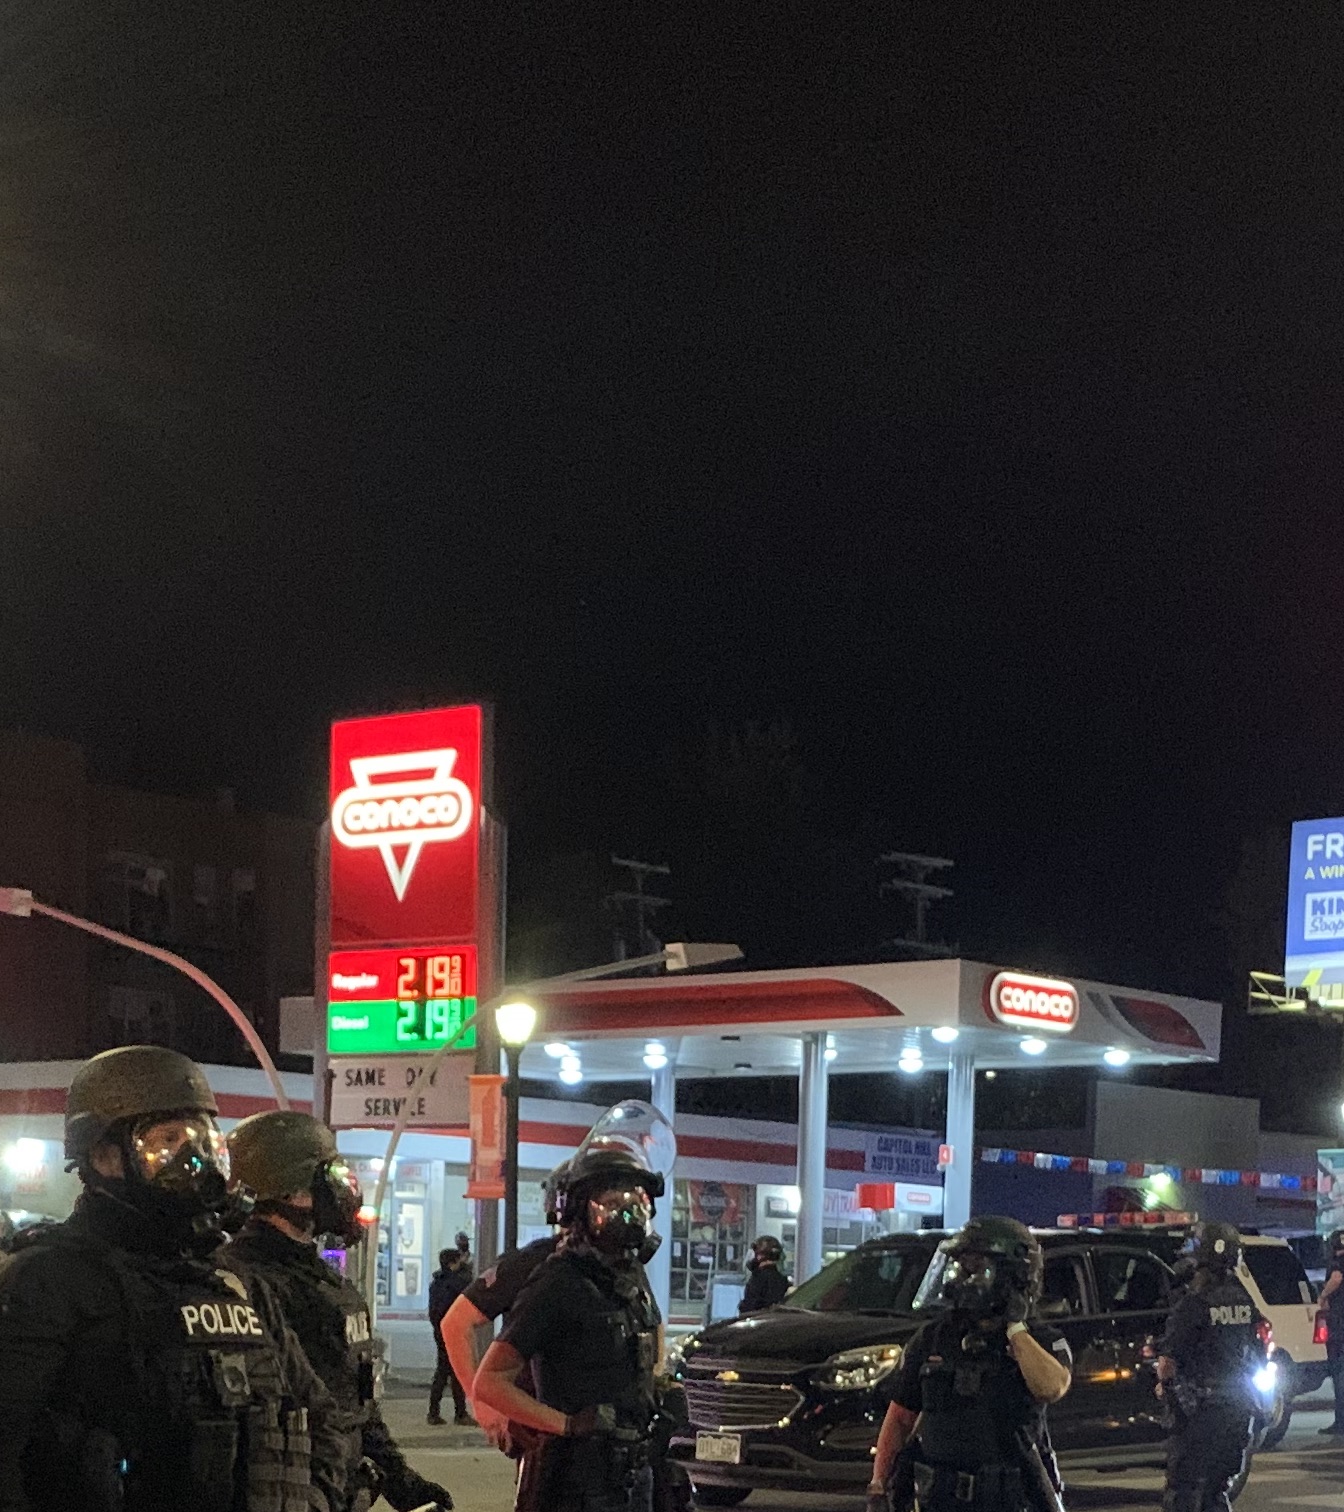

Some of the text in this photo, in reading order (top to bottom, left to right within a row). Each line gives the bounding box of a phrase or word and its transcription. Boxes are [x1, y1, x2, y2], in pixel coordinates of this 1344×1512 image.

[1304, 867, 1315, 879] A
[345, 1068, 385, 1086] SAME
[364, 1097, 425, 1116] SERVE
[181, 1303, 263, 1336] POLICE
[1209, 1305, 1252, 1325] POLICE
